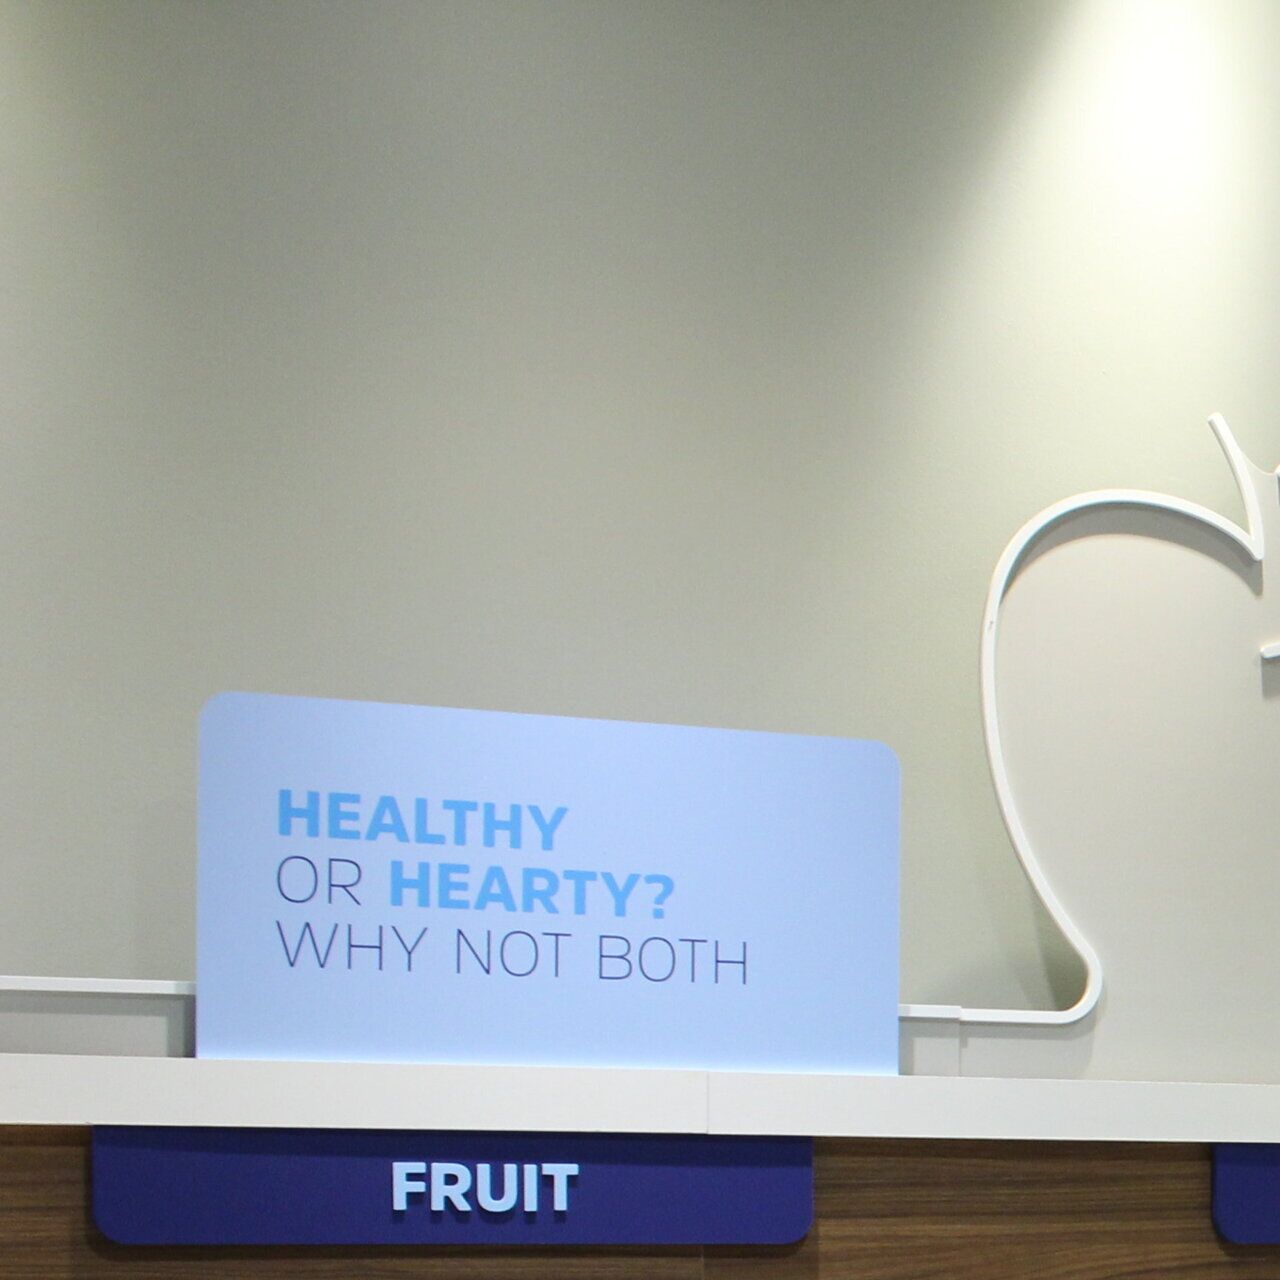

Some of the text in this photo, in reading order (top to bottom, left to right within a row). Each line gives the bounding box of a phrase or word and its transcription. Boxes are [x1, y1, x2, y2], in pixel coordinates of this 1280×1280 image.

[277, 788, 569, 852] HEALTHY
[277, 855, 675, 920] OR HEARTY?
[275, 920, 749, 986] WHY NOT BOTH
[392, 1161, 579, 1213] FRUIT
